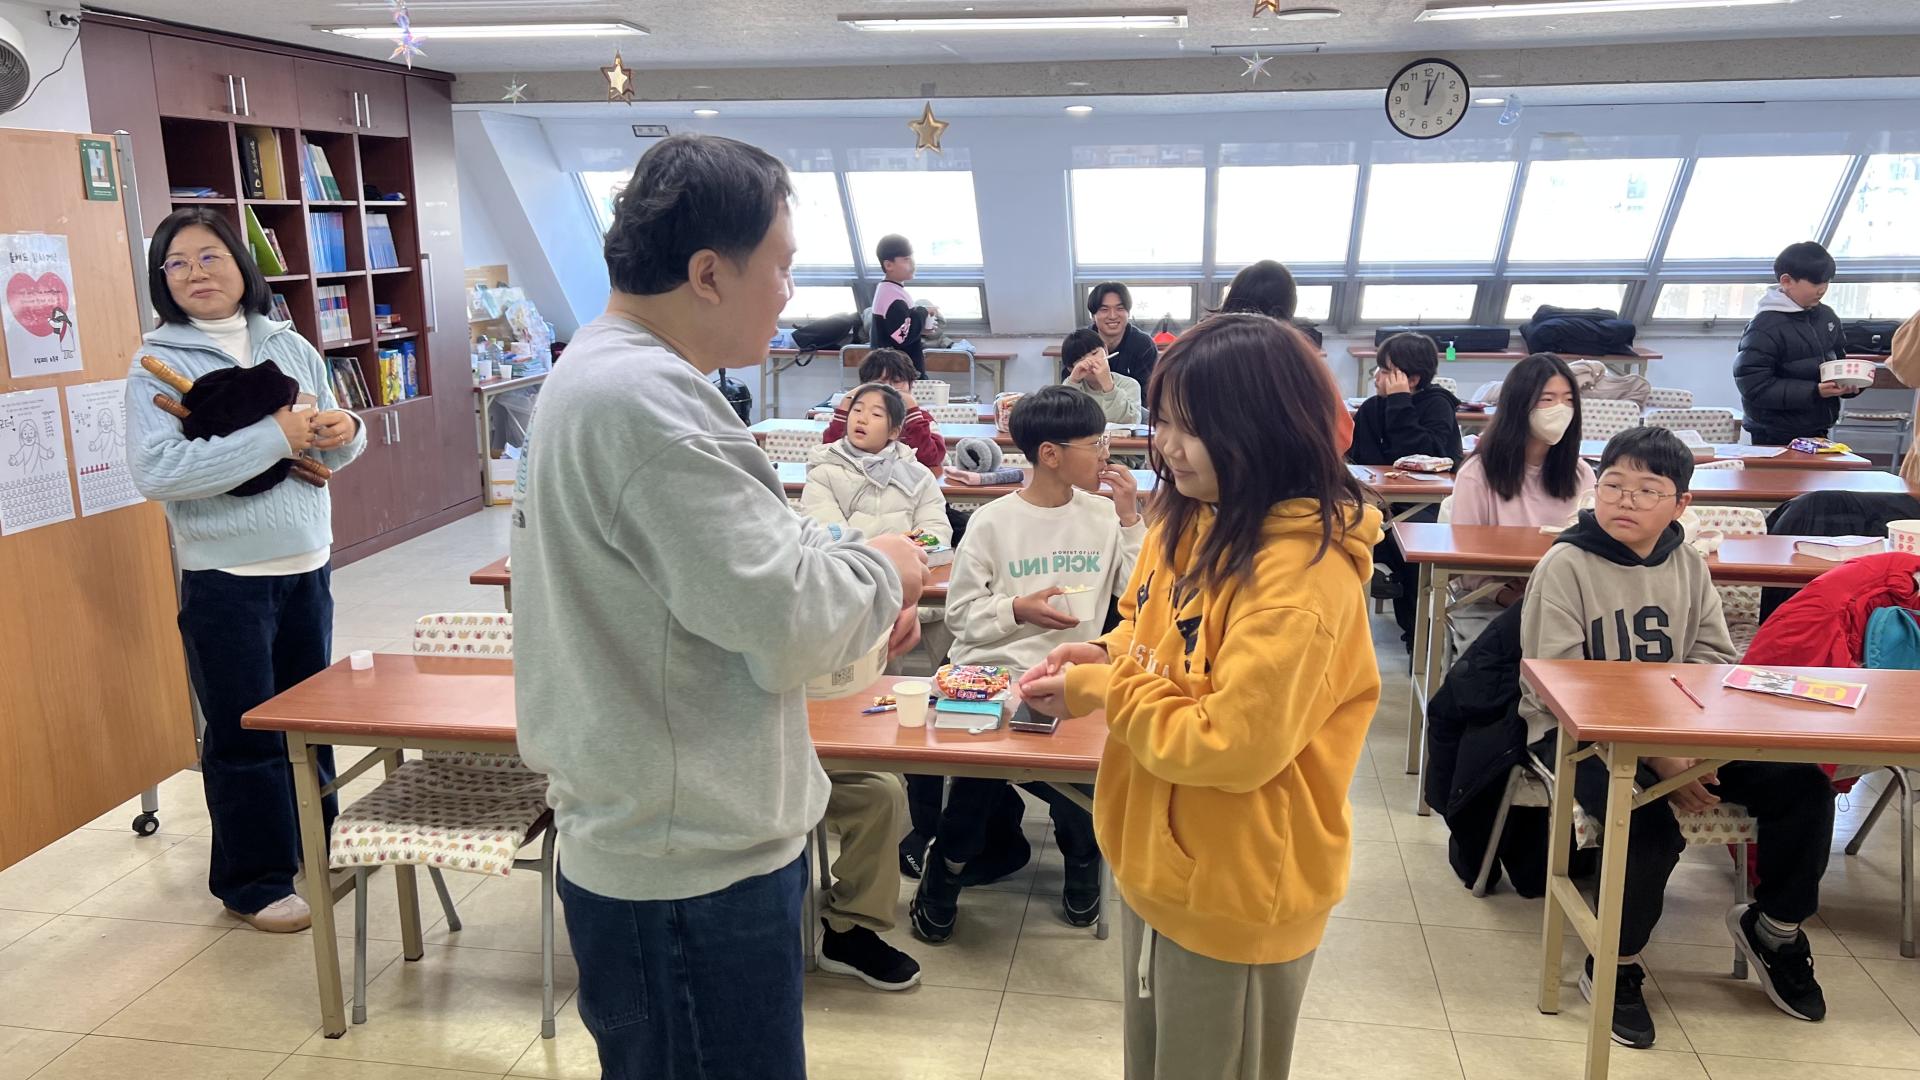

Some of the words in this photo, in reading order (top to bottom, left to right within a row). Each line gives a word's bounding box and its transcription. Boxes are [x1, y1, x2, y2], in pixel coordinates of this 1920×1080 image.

[1410, 72, 1418, 80] 11
[1424, 67, 1434, 76] 12
[1400, 82, 1409, 91] 10
[1449, 80, 1456, 89] 2
[1395, 96, 1402, 104] 9
[1452, 94, 1459, 102] 3
[1399, 109, 1406, 118] 8
[1446, 108, 1453, 116] 4
[1409, 118, 1415, 127] 7
[1421, 120, 1428, 129] 6
[1436, 116, 1443, 125] 5
[1008, 557, 1048, 578] UNI
[1052, 555, 1101, 573] PICK
[1591, 606, 1674, 663] US
